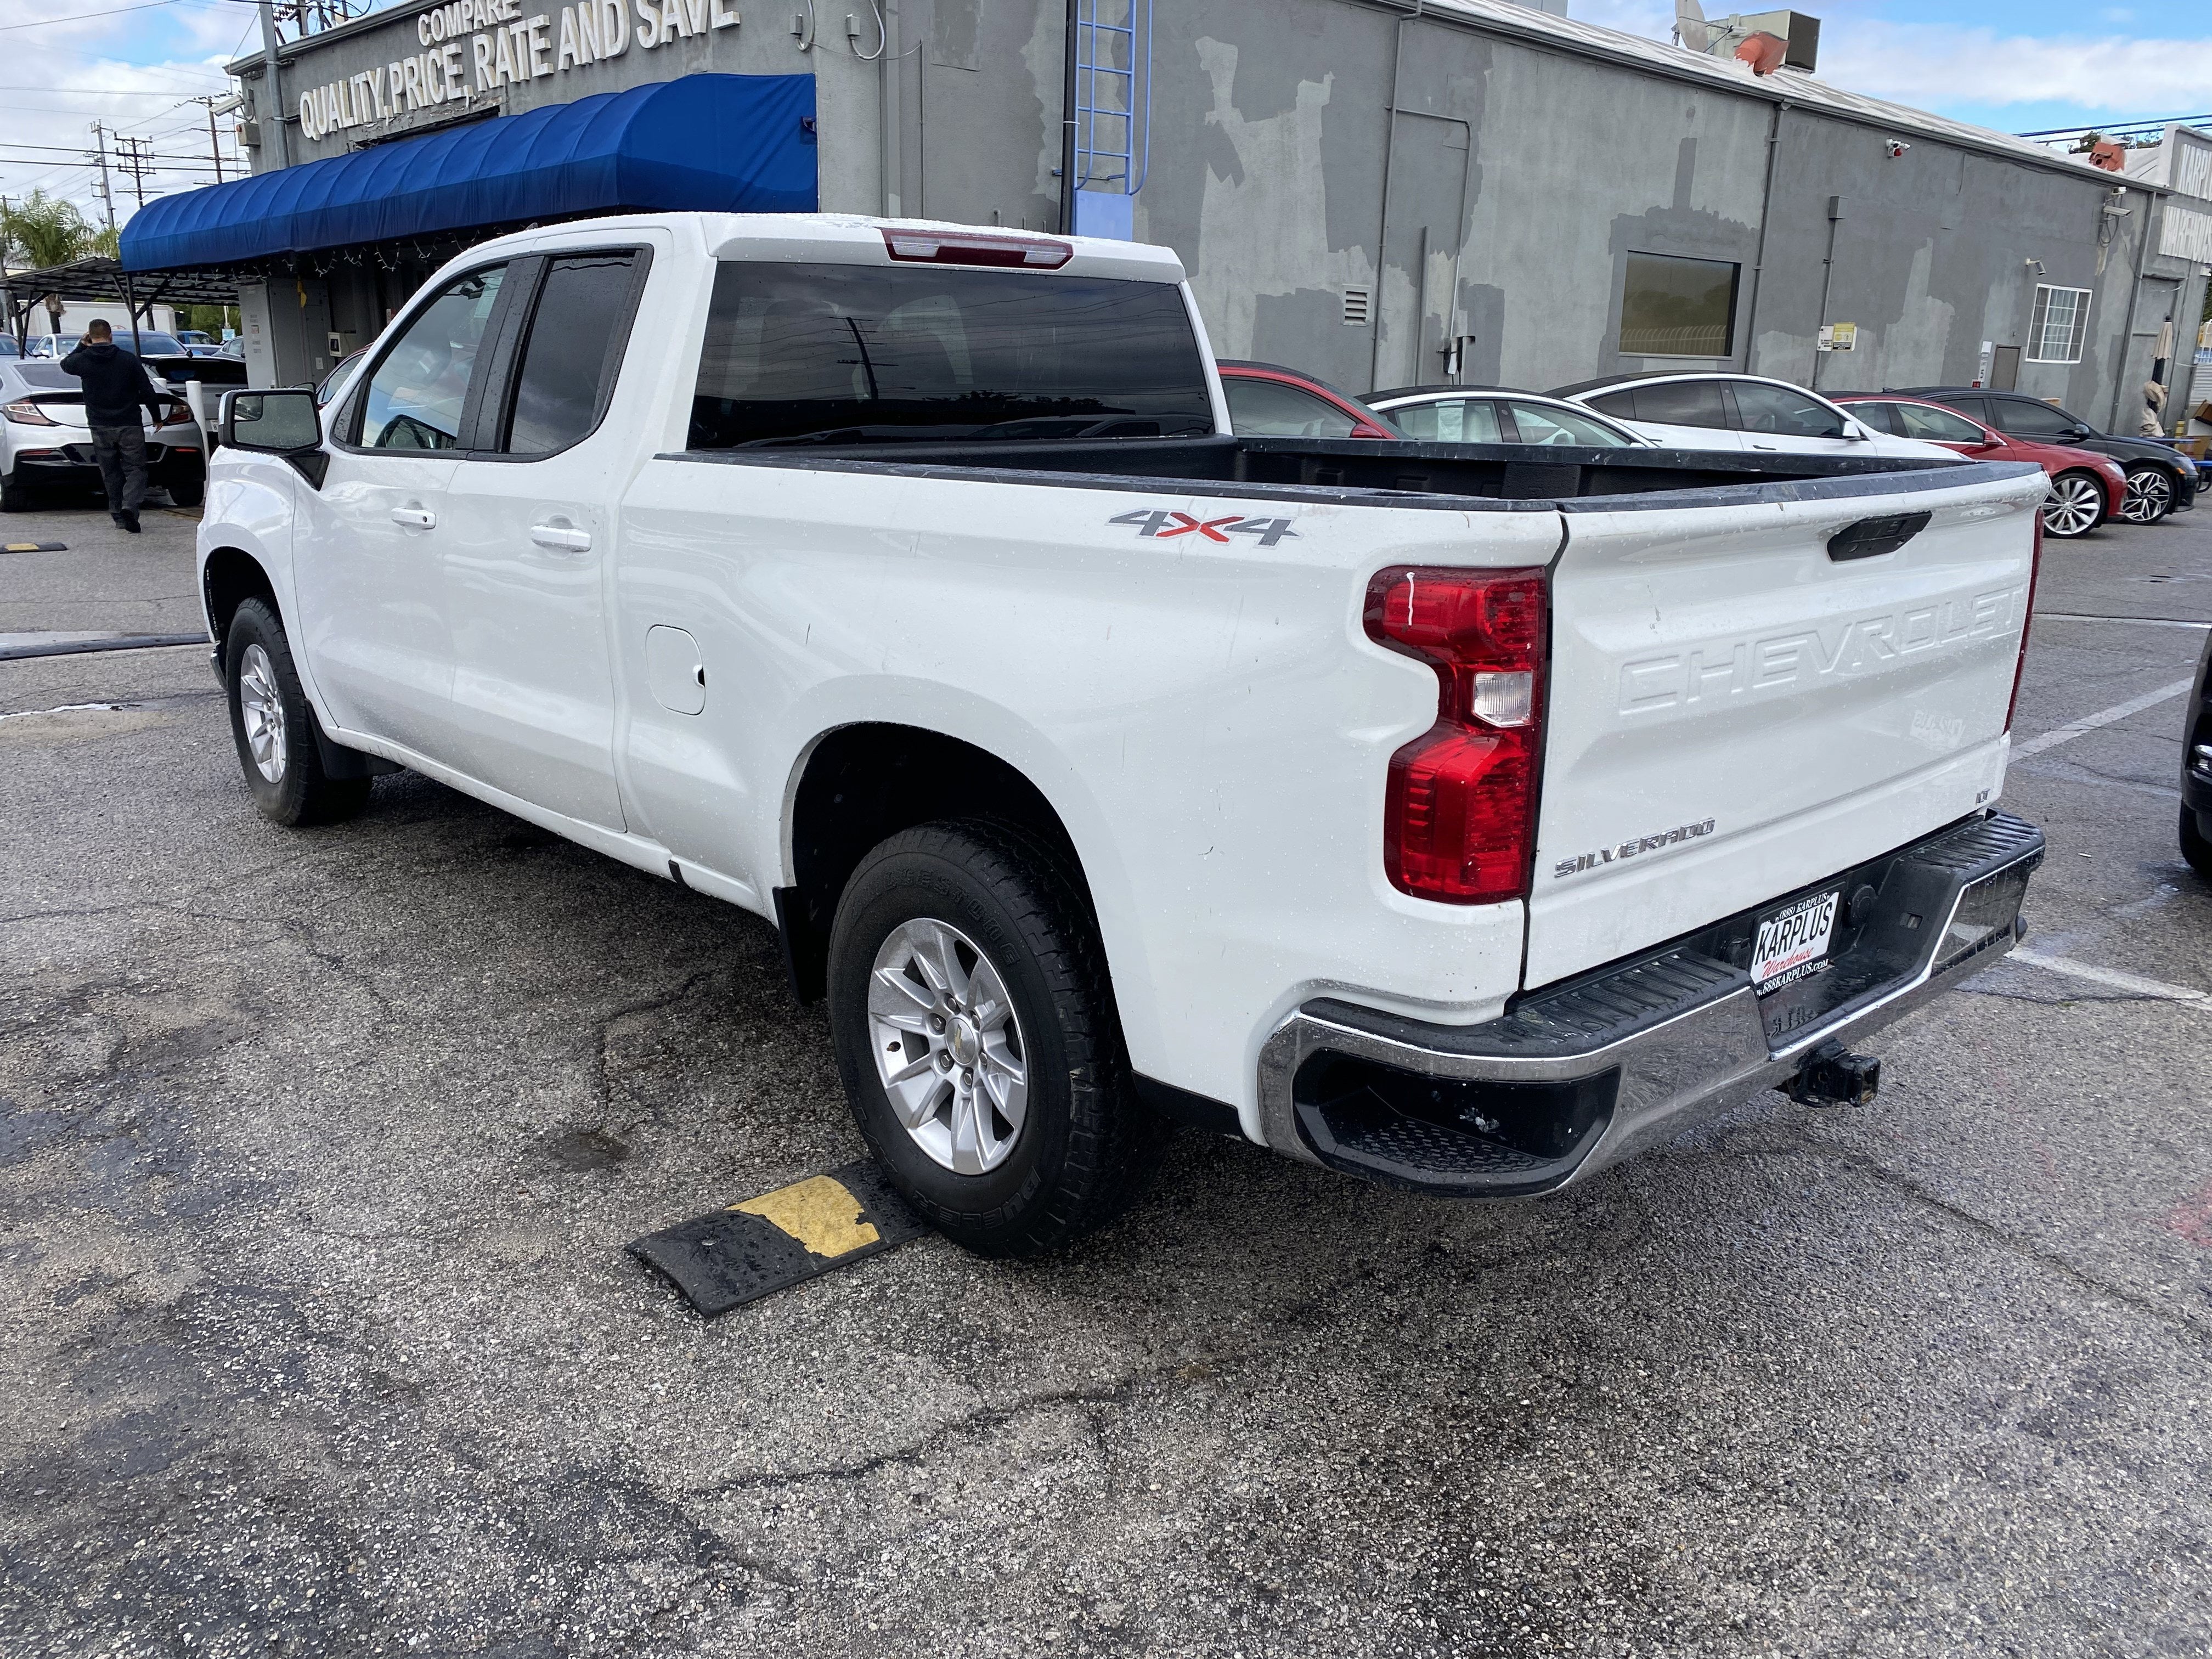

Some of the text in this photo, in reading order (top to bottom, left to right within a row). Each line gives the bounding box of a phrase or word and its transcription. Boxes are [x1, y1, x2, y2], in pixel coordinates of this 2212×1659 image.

[417, 0, 522, 46] COMPARE
[472, 14, 554, 92] RATE
[558, 0, 631, 70] AND
[1108, 510, 1300, 546] 4X4
[1620, 584, 2022, 714] CHEVROLET
[1554, 817, 1715, 878] SILVERADO
[1755, 901, 1832, 965] KARPLUS
[1779, 906, 1796, 920] (888)
[1762, 947, 1814, 979] Warehouse
